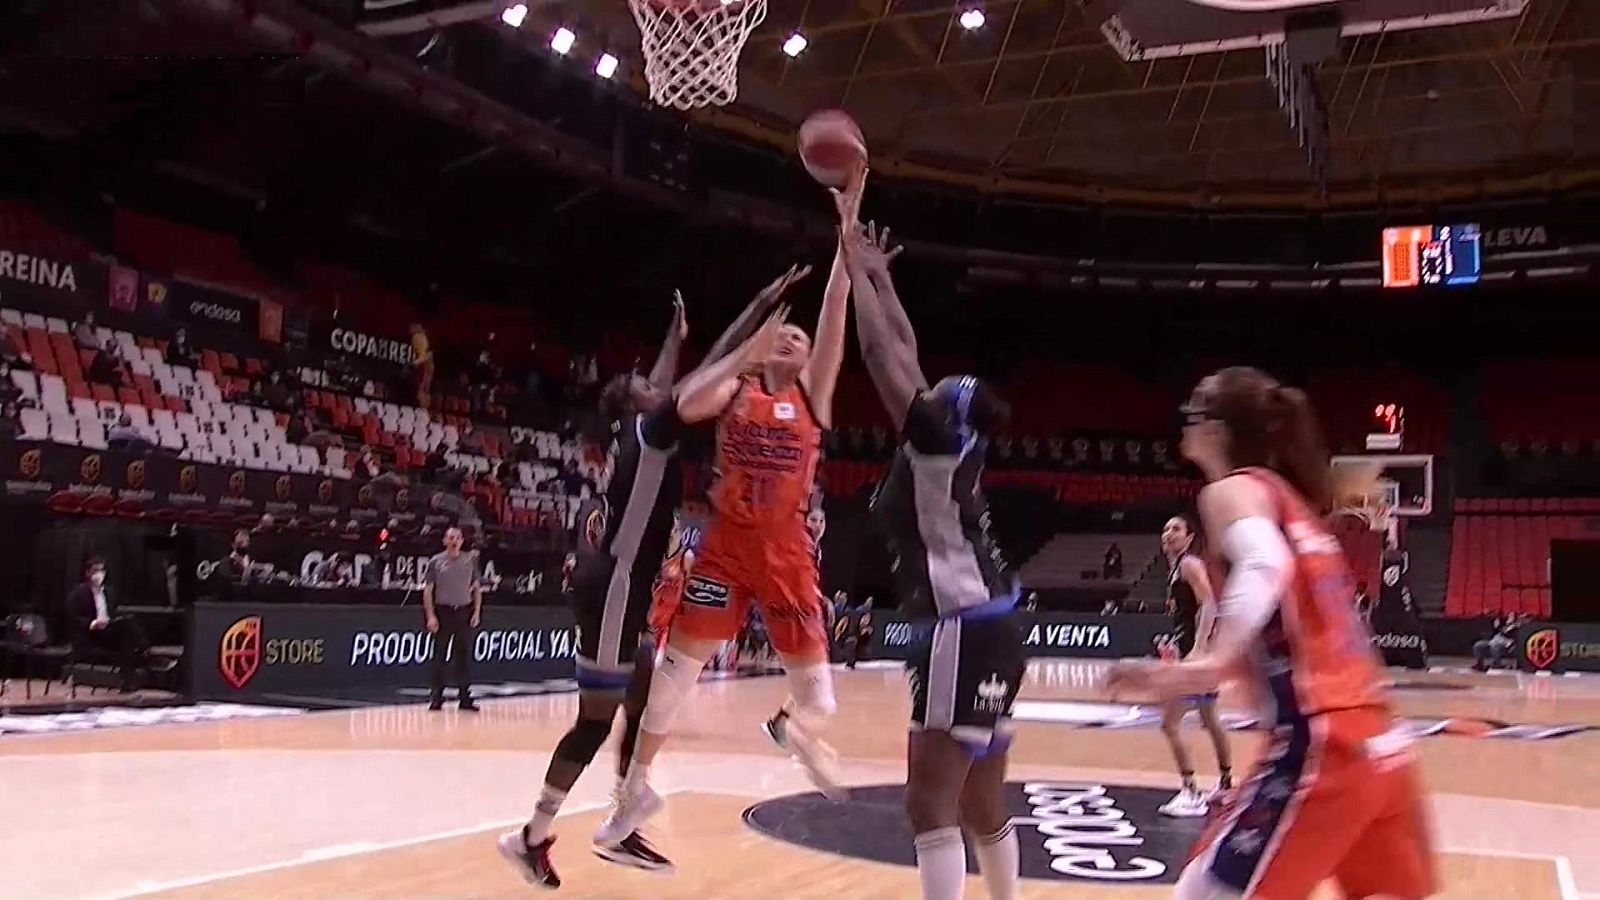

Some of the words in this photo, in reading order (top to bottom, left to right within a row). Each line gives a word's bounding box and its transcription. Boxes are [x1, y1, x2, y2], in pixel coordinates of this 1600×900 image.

[0, 250, 77, 292] REINA
[331, 328, 378, 357] COPA
[389, 341, 417, 364] REI
[266, 637, 325, 665] STORE
[351, 631, 455, 666] PRODU
[474, 631, 545, 661] OFICIAL
[1046, 624, 1110, 648] VENTA
[1371, 632, 1420, 648] ndesa
